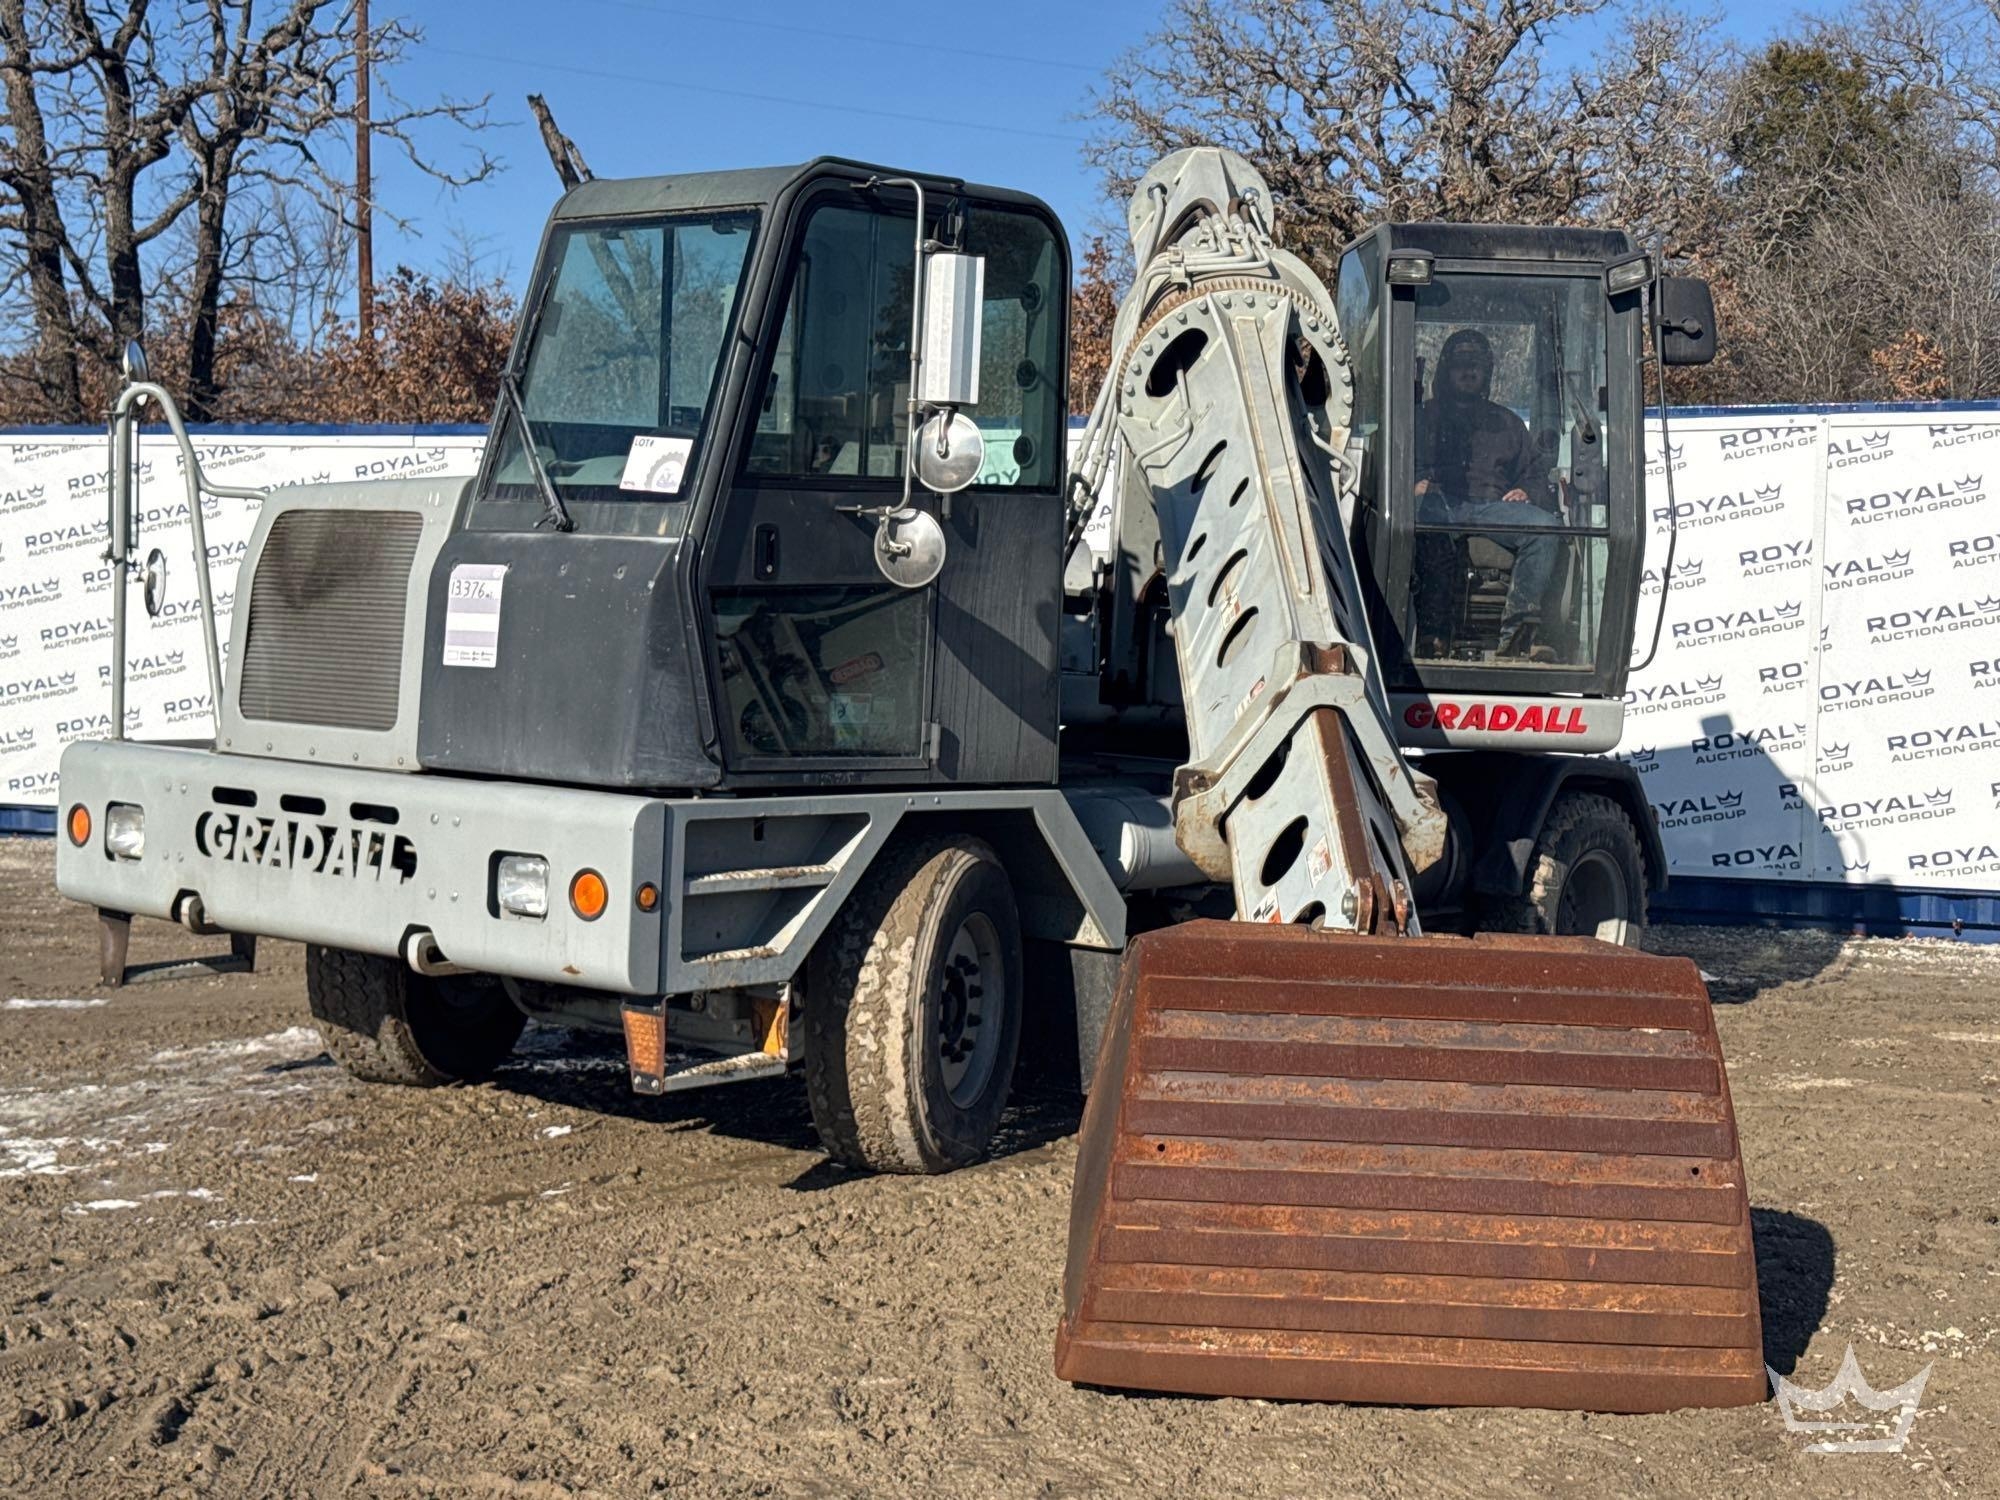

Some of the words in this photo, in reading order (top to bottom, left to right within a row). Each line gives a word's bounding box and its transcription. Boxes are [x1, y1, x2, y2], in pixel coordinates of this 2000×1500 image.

[14, 449, 59, 464] AUCTION
[228, 452, 266, 466] GROUP
[1723, 440, 1794, 461] AUCTION
[1836, 449, 1894, 468] GROUP
[355, 453, 427, 478] ROYAL
[409, 462, 449, 476] GROUP
[68, 471, 110, 491] ROY
[12, 499, 47, 513] GROUP
[1653, 492, 1755, 522] ROYAL
[1846, 482, 1955, 514] ROYAL
[136, 504, 190, 524] ROYA
[1729, 502, 1785, 520] GROUP
[1850, 505, 1924, 526] AUCTION
[1927, 493, 1987, 512] GROUP
[25, 524, 92, 548] ROYAL
[28, 541, 73, 557] AUCTION
[75, 535, 110, 548] GROUP
[1739, 538, 1813, 566] ROY
[1953, 552, 2000, 569] AUCT
[1823, 557, 1884, 578] YAL
[1856, 568, 1914, 586] GROUP
[0, 583, 42, 600] YAL
[1, 601, 25, 611] TION
[26, 593, 62, 605] GROUP
[151, 614, 198, 629] AUCTION
[1672, 608, 1775, 638] ROYAL
[1866, 602, 1975, 633] ROYAL
[40, 618, 108, 641] ROYAL
[1675, 630, 1745, 650] AUCTION
[1748, 619, 1805, 637] GROUP
[1870, 624, 1944, 645] AUCTION
[43, 636, 88, 650] AUCTION
[91, 631, 114, 641] GRO
[0, 649, 20, 659] OUP
[98, 656, 166, 678] RYAL
[149, 665, 187, 679] GROUP
[42, 686, 78, 699] GROUP
[1624, 681, 1697, 705] OYAL
[1762, 679, 1808, 695] AUCT
[1820, 675, 1904, 701] OYAL
[1876, 687, 1935, 704] GROUP
[163, 694, 212, 714] ROY
[1623, 702, 1668, 717] CTION
[1671, 693, 1726, 709] GROUP
[56, 714, 112, 734] ROYA
[1404, 703, 1588, 734] GRADALL
[1691, 725, 1795, 753] ROYAL
[1887, 722, 1997, 751] ROYAL
[1695, 747, 1765, 765] AUCTION
[1768, 740, 1806, 753] GRO
[1891, 744, 1965, 763] AUCTION
[1816, 760, 1854, 775] OUP
[8, 771, 60, 791] ROYA
[1658, 796, 1717, 817] YAL
[1691, 809, 1746, 825] GROUP
[1818, 794, 1925, 822] ROYAL
[1821, 816, 1894, 834] AUCTION
[1897, 807, 1956, 823] GROUP
[202, 811, 406, 884] GRADALL
[1712, 842, 1802, 867] ROYA
[1908, 845, 1999, 870] ROYA
